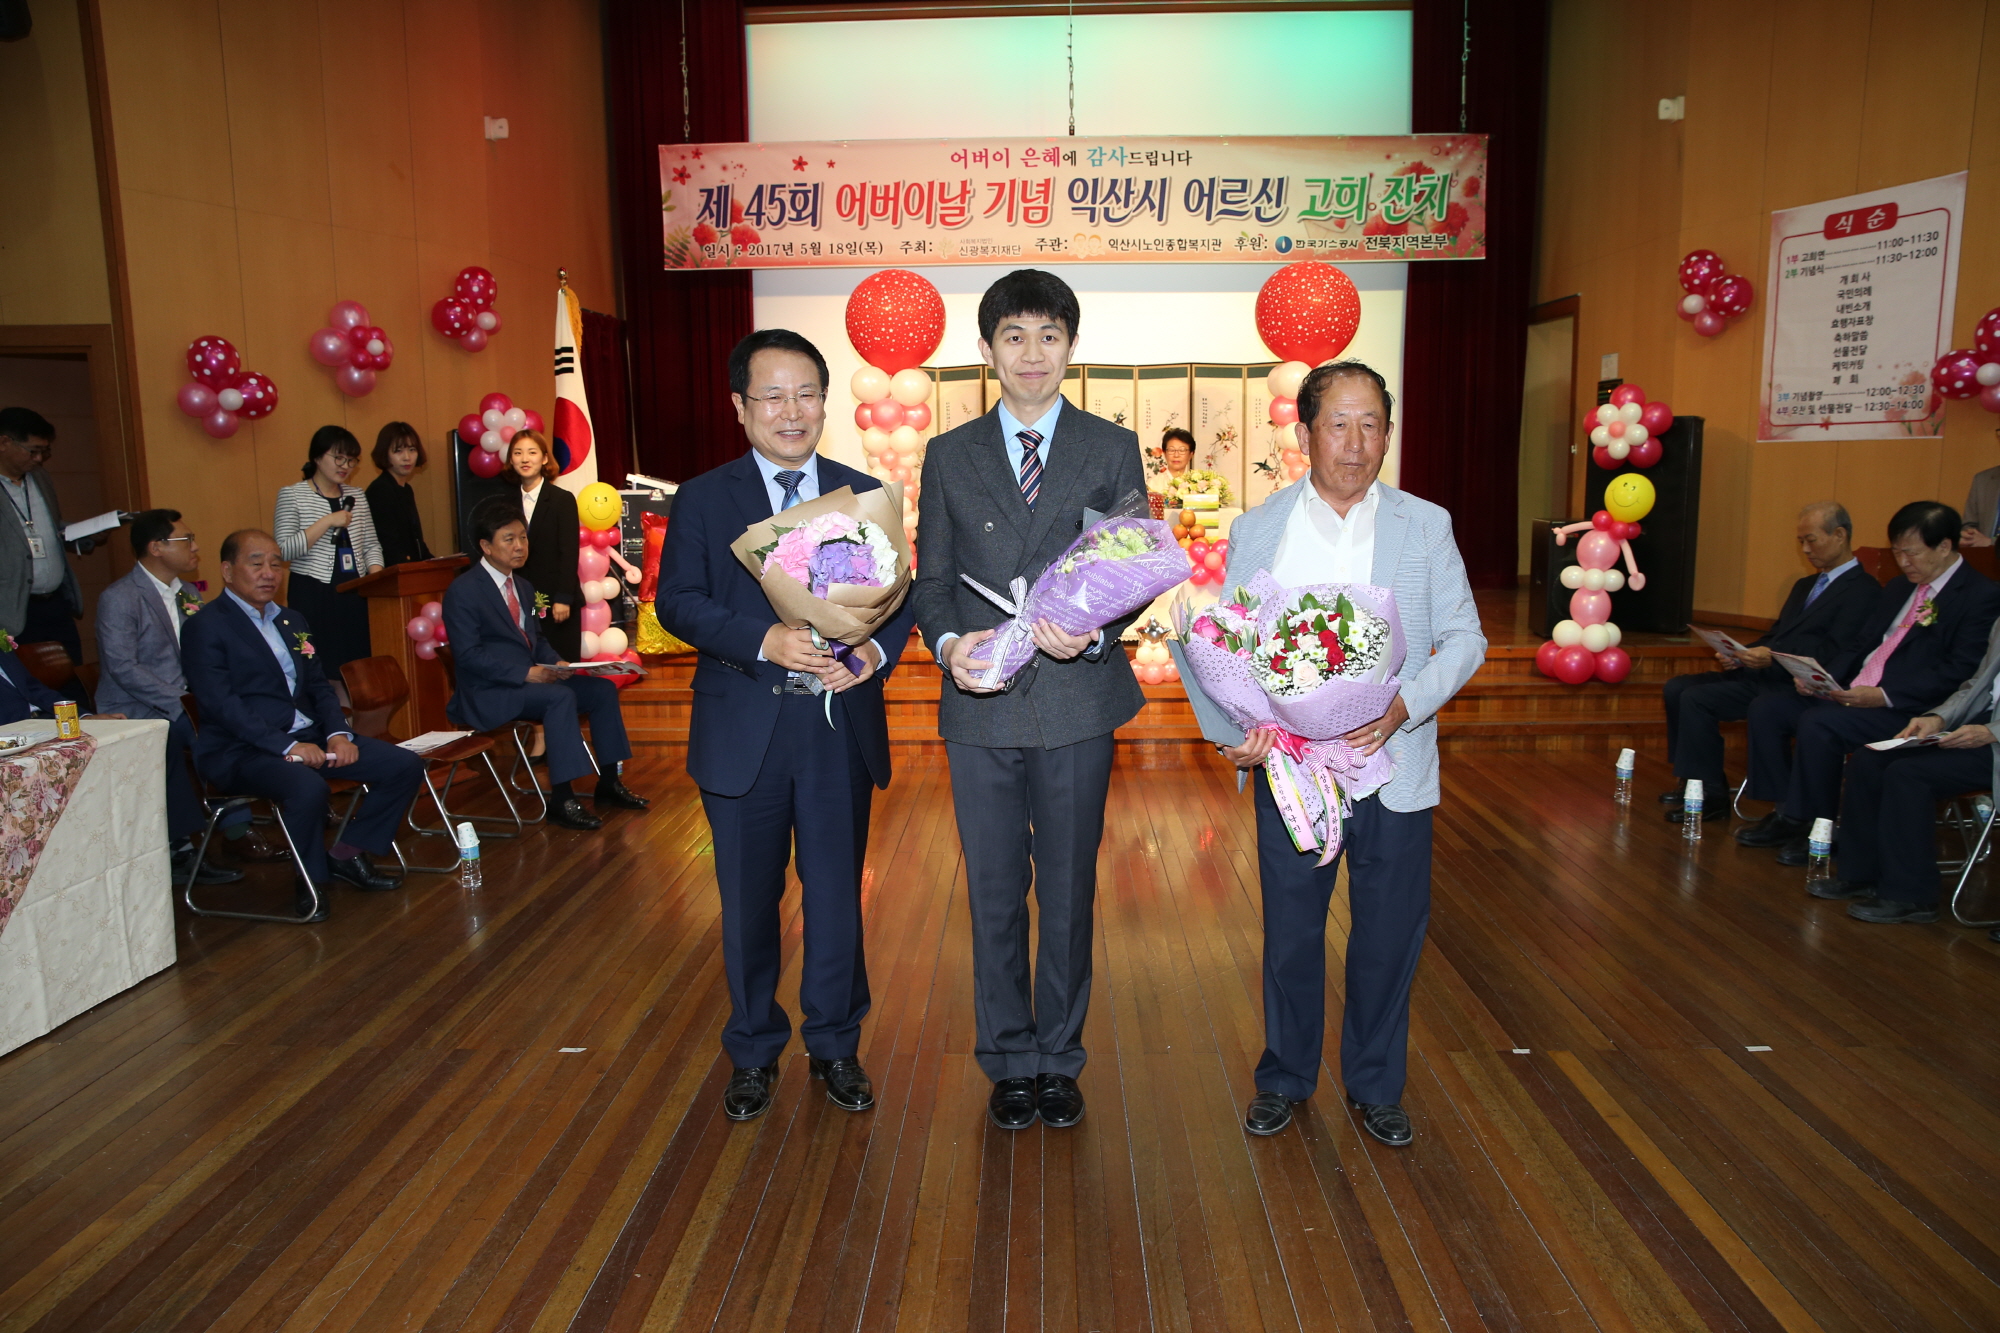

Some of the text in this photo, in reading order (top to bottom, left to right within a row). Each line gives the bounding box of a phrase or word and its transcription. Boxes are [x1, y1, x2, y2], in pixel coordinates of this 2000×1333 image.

[950, 145, 1193, 169] 어버이 은혜에 감사드립니다
[696, 173, 1453, 229] 제 45회 어버이날 기념 익산시 어르신 고희 잔치
[1834, 207, 1886, 234] 식 순
[704, 243, 731, 258] 일시
[748, 242, 794, 257] 2017년
[800, 241, 822, 257] 5월
[828, 240, 884, 256] 18일(목)
[899, 239, 933, 255] 주최:
[958, 244, 1021, 257] 신광복지재단
[1034, 237, 1222, 252] 주관: 익산시노인종합복지관
[1234, 234, 1449, 252] 후원: 한국가스공사 전북지역본부
[1786, 230, 1939, 265] 1부 고희연 11:00-11:30
[1784, 247, 1938, 279] 2부 기념식 11:30-12:00
[1836, 285, 1872, 300] 국민의례
[1836, 300, 1871, 314] 내빈소개
[1830, 314, 1874, 329] 효행자표창
[1833, 344, 1868, 358] 선물전달
[1777, 384, 1926, 402] 3부 기념촬영 12:00-12:30
[1776, 406, 1789, 415] 4부
[1818, 403, 1853, 415] 선물전달
[1084, 569, 1115, 590] oubliable
